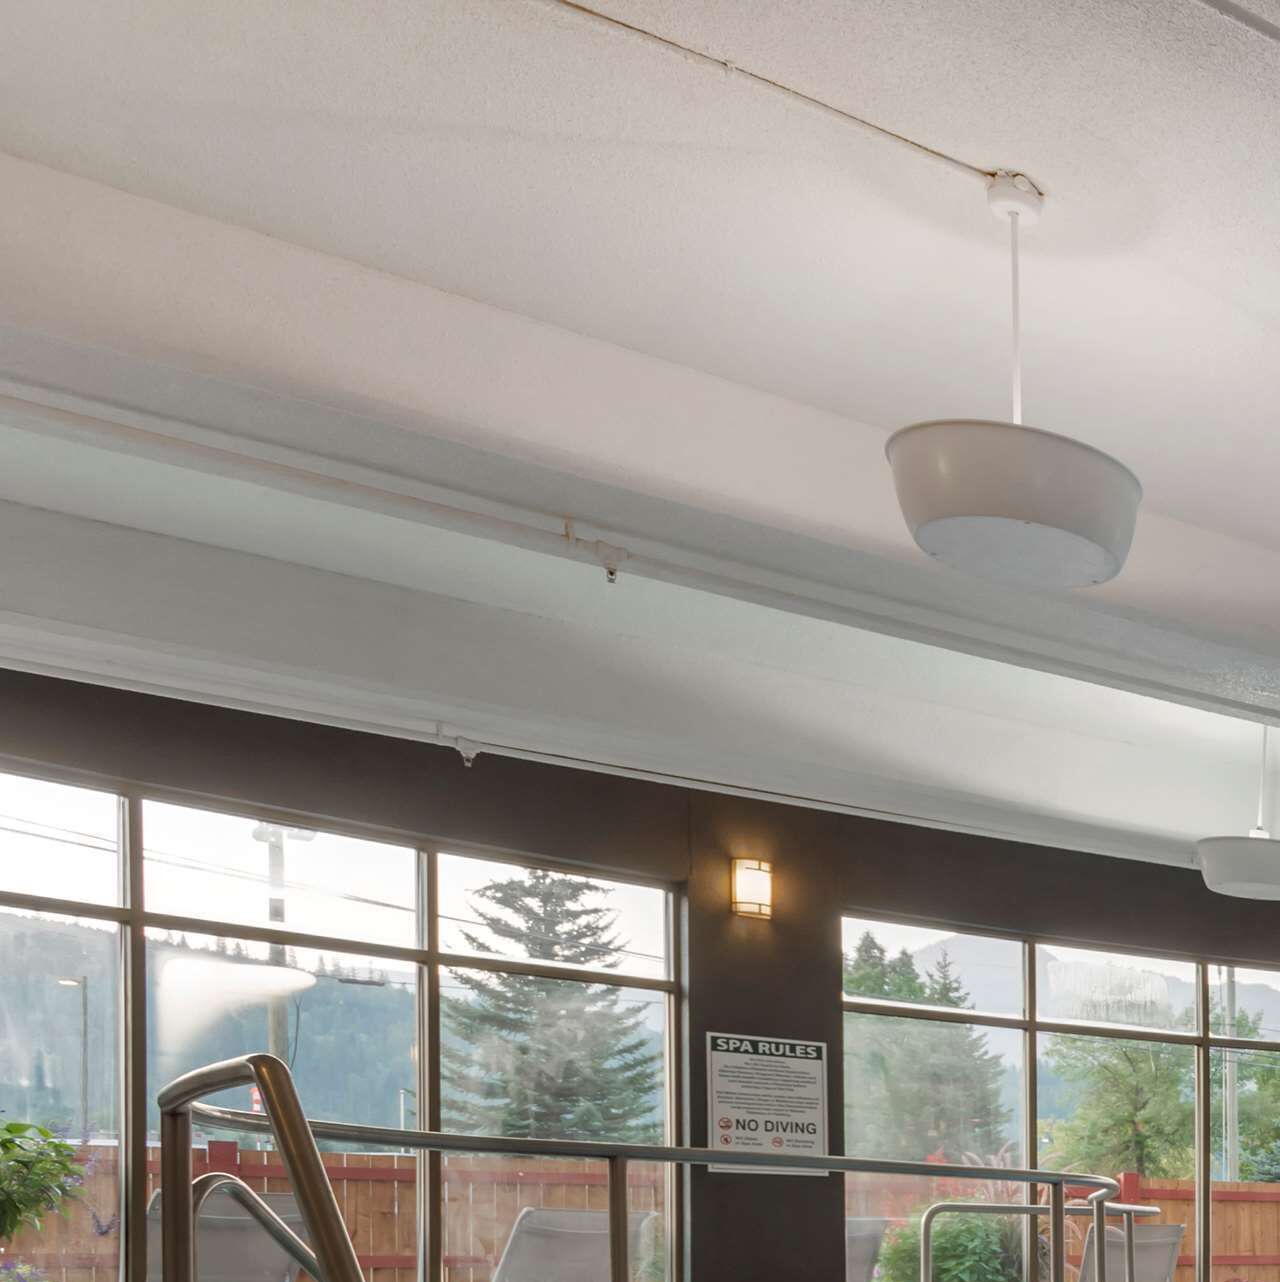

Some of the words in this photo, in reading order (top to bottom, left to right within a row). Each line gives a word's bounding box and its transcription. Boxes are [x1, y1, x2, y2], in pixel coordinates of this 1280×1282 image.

[716, 1038, 754, 1054] SPA
[758, 1042, 818, 1058] RULES
[735, 1118, 760, 1132] NO
[764, 1120, 817, 1135] DIVING
